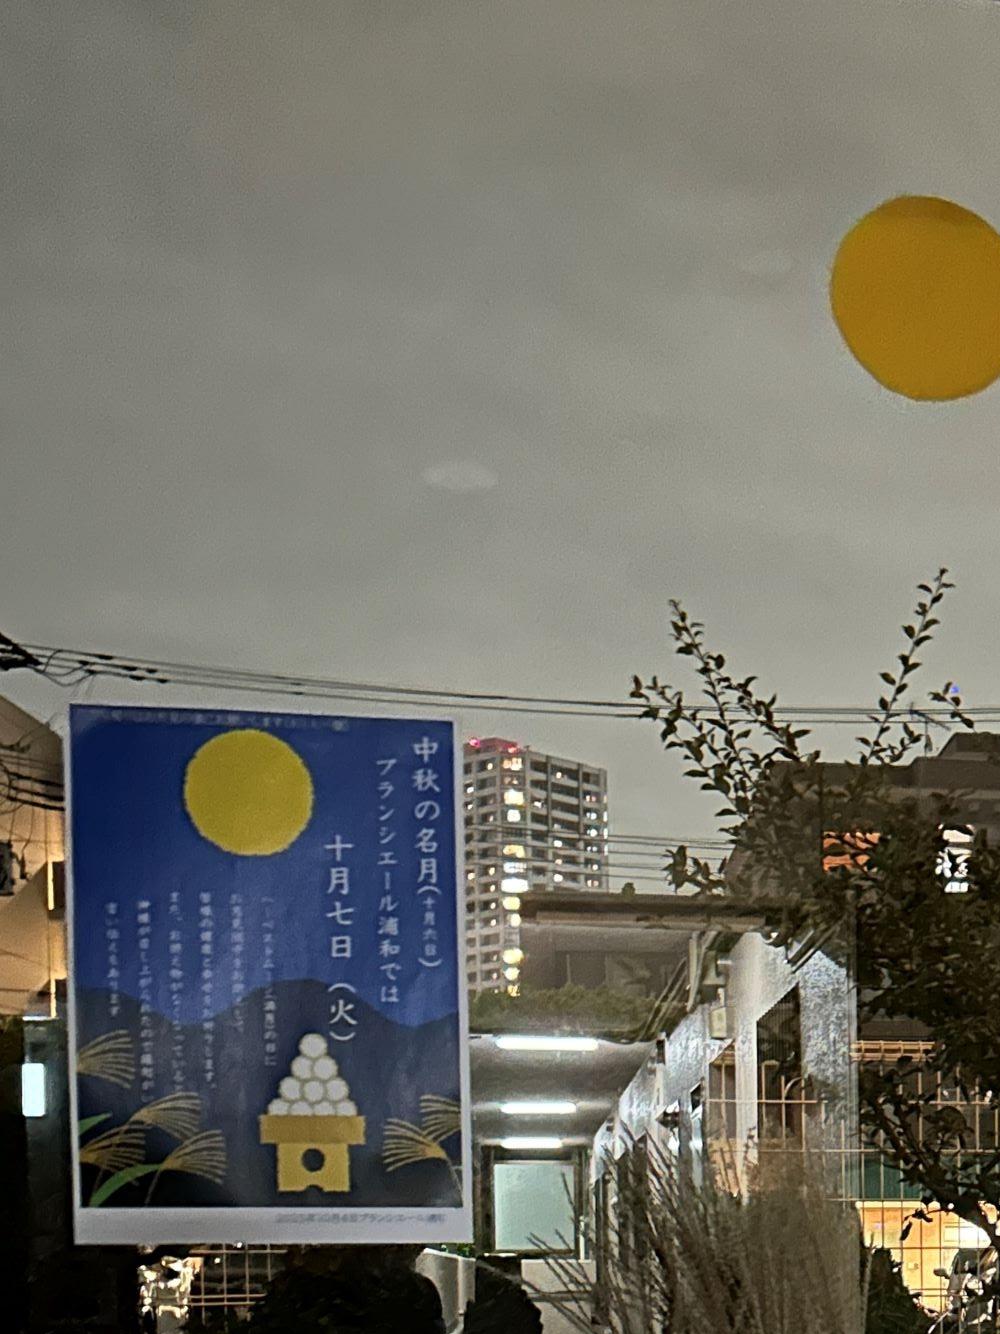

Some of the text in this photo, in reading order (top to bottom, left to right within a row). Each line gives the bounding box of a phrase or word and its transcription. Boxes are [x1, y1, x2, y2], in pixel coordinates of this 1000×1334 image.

[323, 834, 357, 1042] 十月七日（火）
